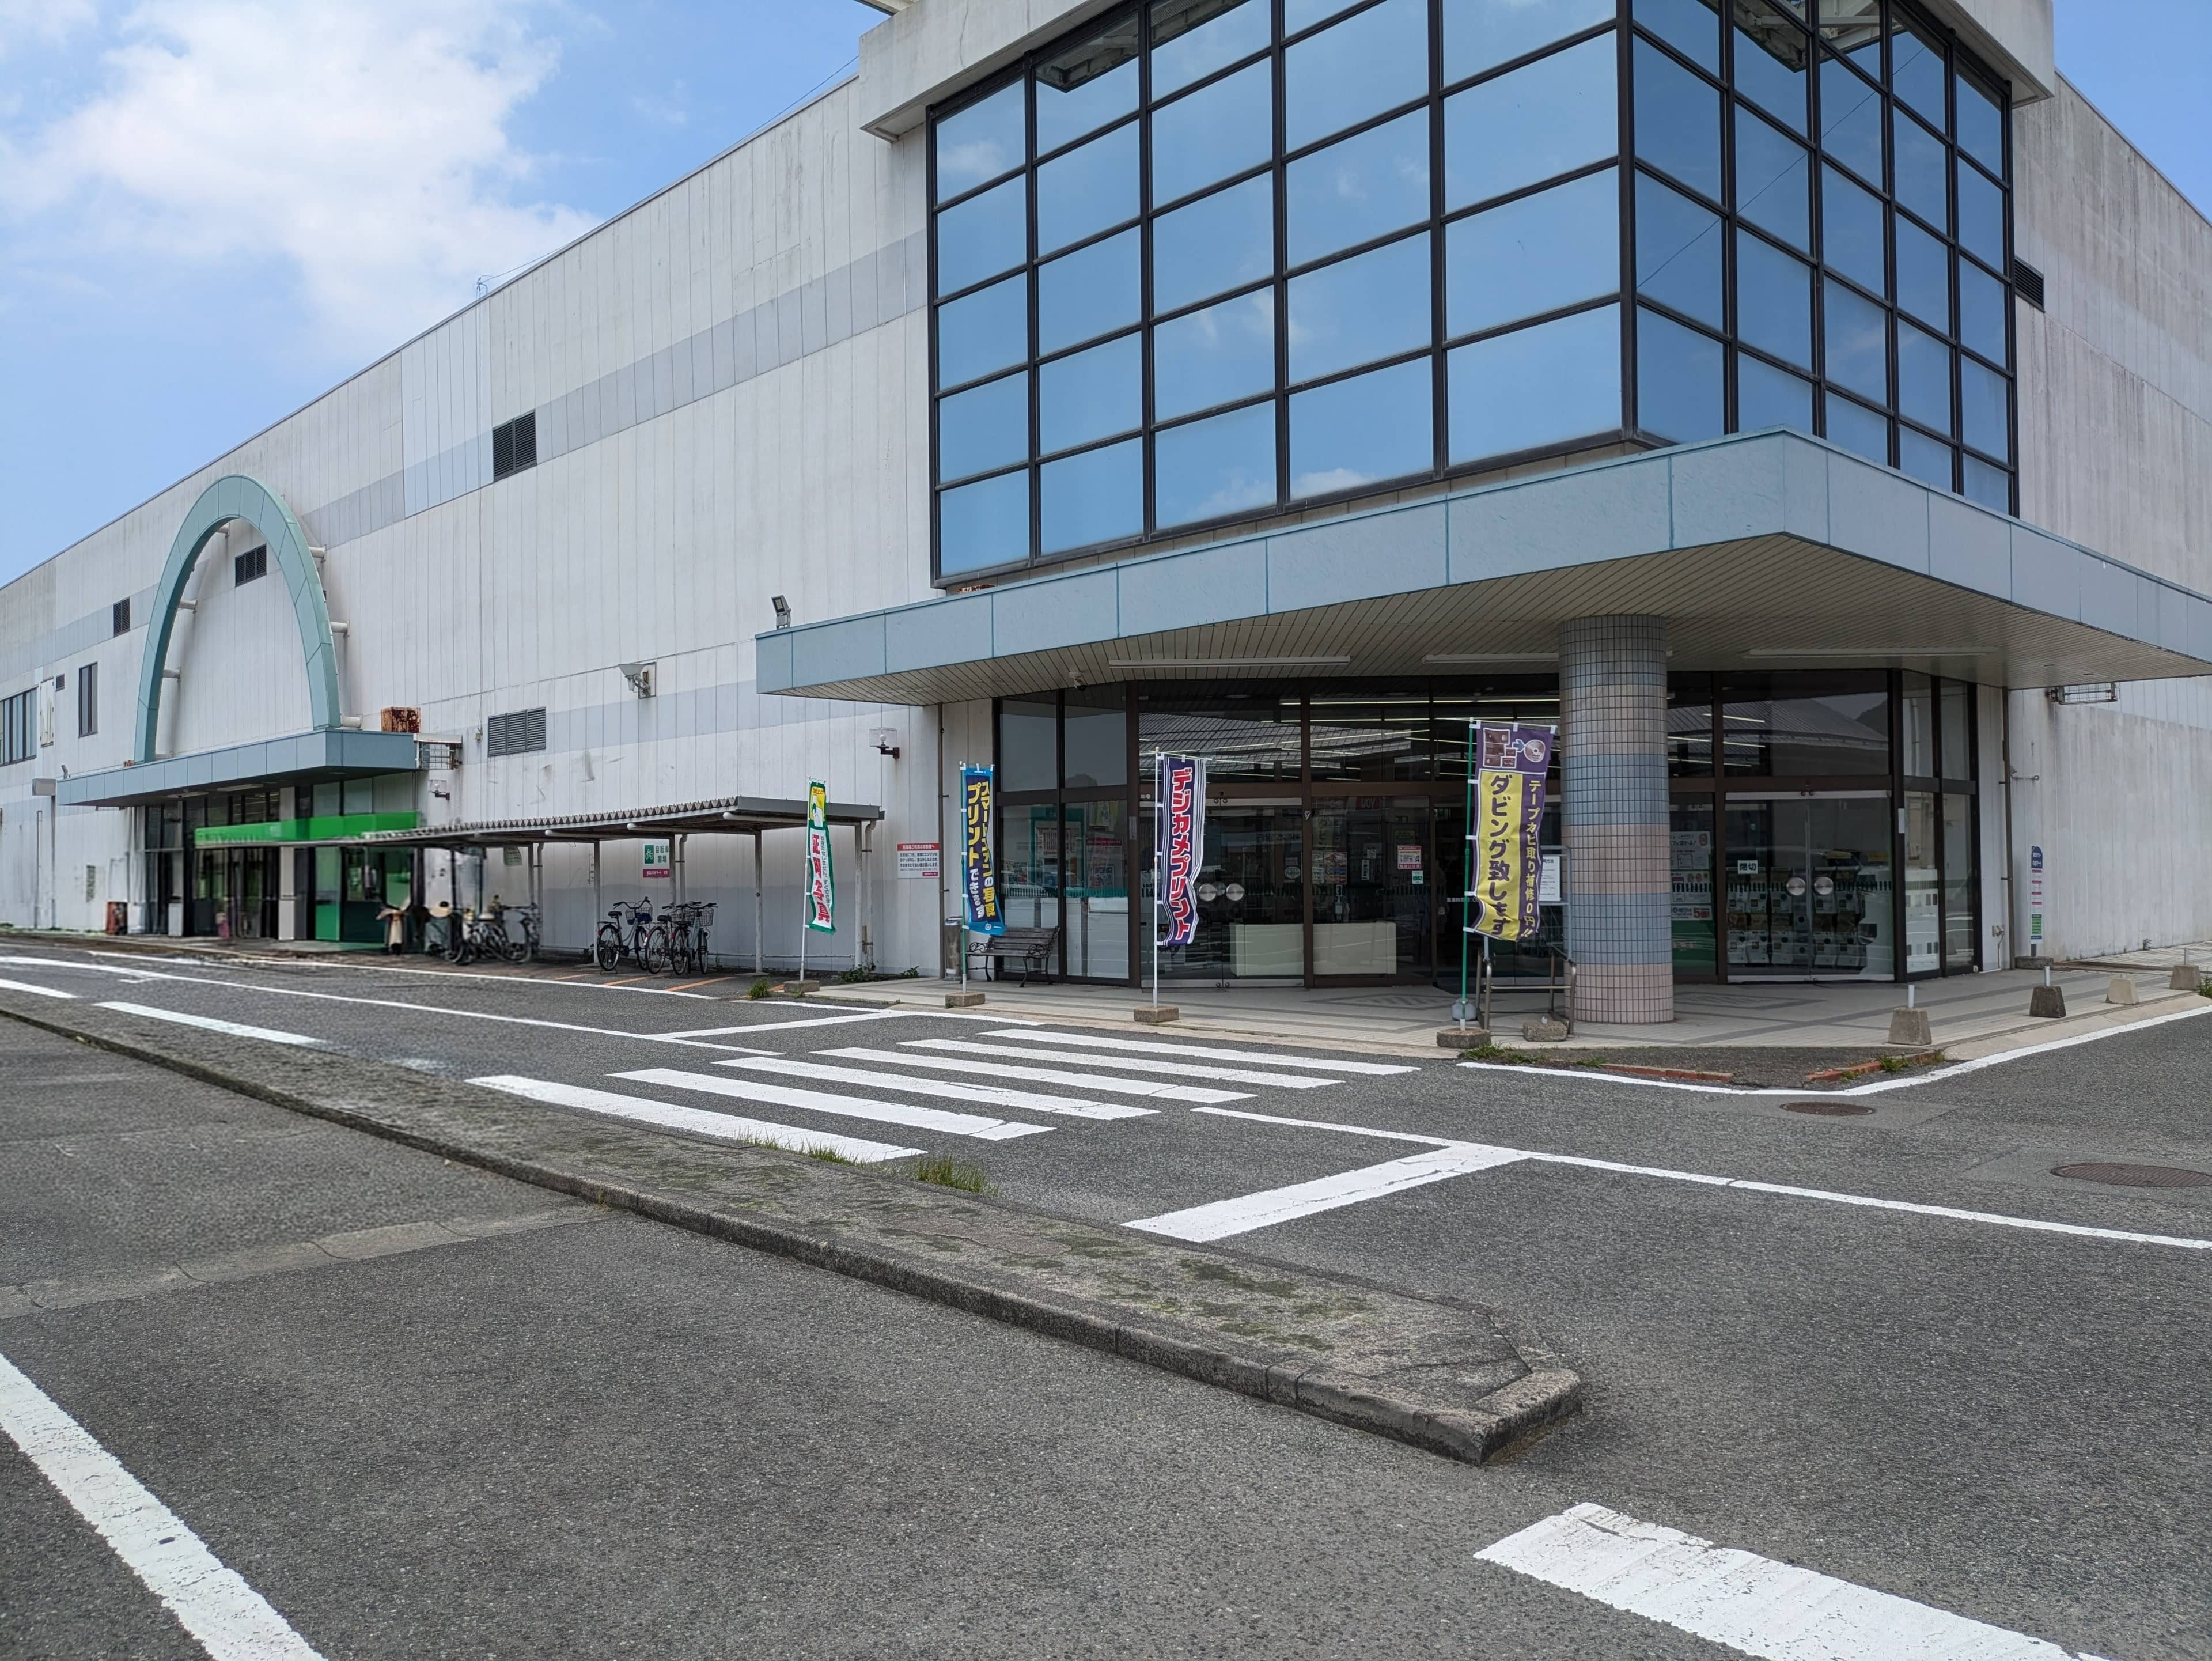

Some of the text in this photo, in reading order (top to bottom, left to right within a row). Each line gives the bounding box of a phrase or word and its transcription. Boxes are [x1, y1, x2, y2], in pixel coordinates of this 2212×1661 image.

[967, 782, 985, 918] プリントできます
[1170, 768, 1192, 940] デジカメプリント
[1488, 774, 1512, 935] ダビング致します
